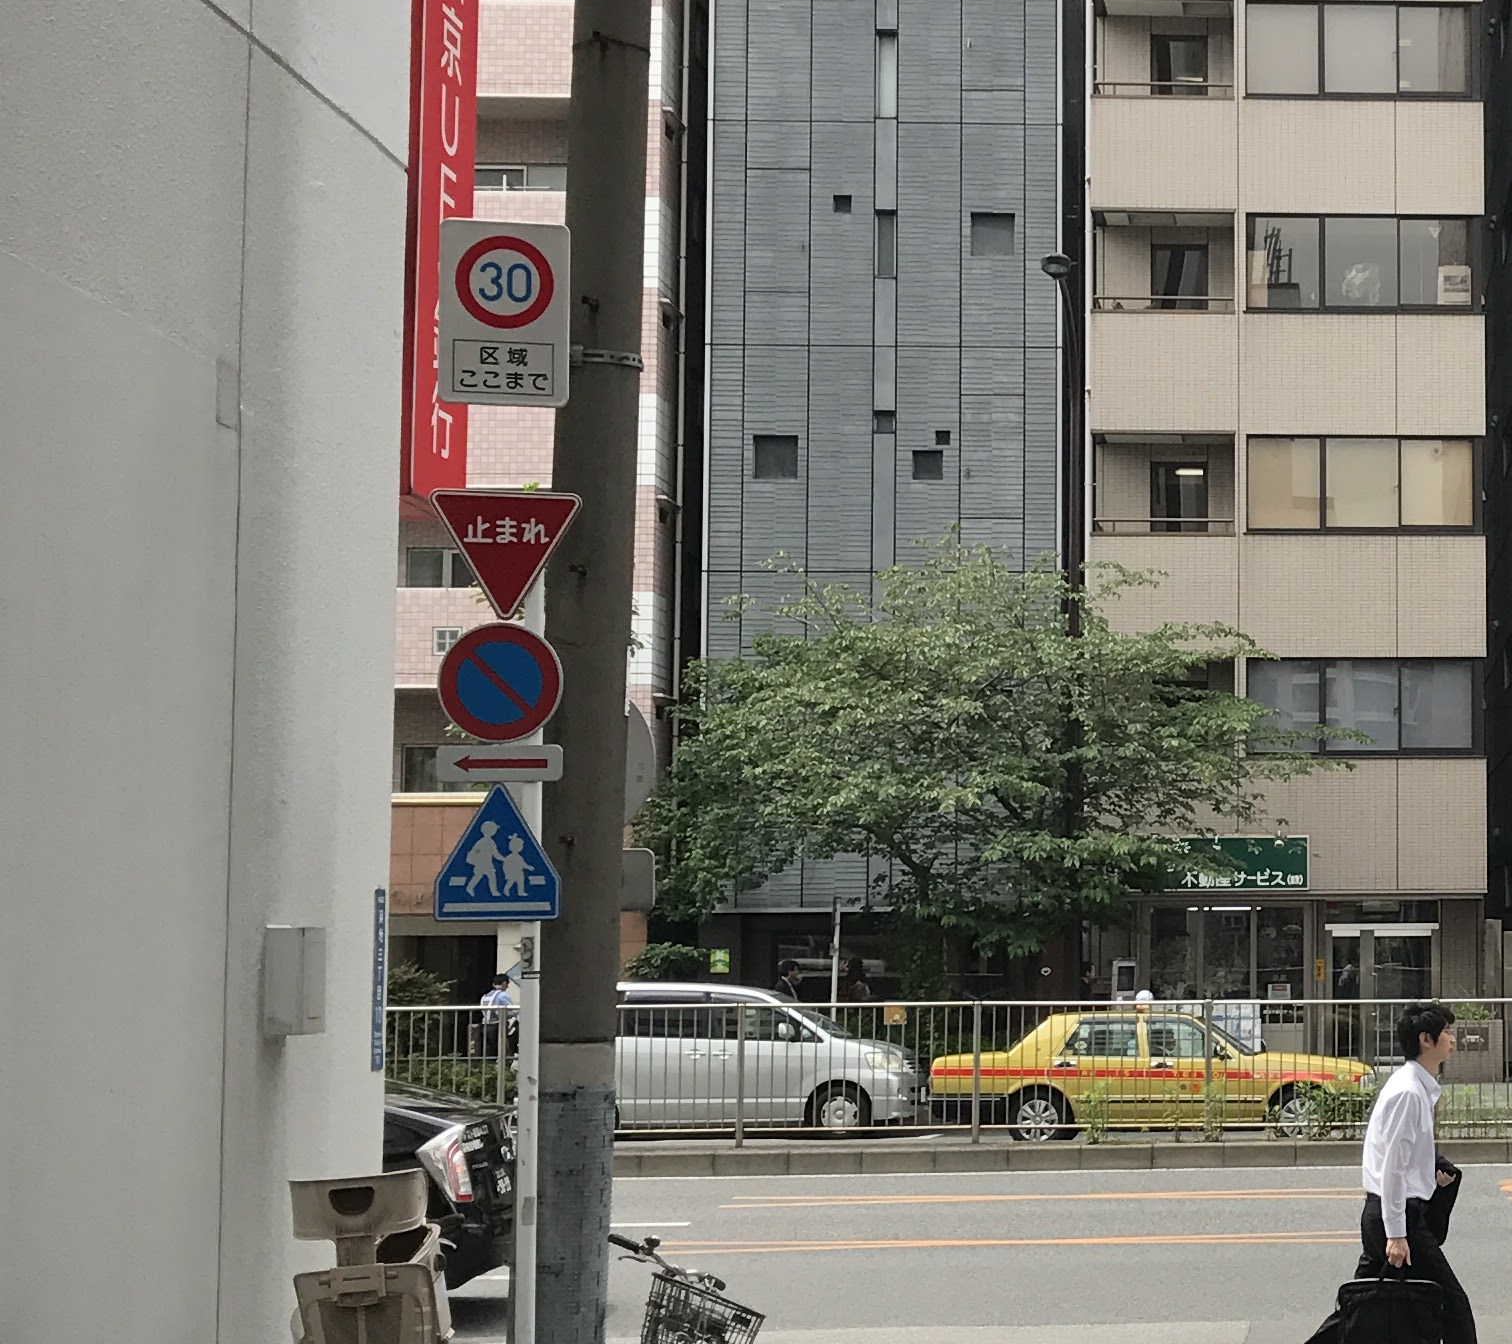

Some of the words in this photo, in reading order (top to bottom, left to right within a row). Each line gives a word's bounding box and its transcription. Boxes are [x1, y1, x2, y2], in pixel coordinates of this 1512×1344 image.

[478, 261, 532, 303] 30
[480, 346, 528, 367] 区域
[459, 369, 549, 391] ここまで
[463, 515, 550, 545] 止まれ
